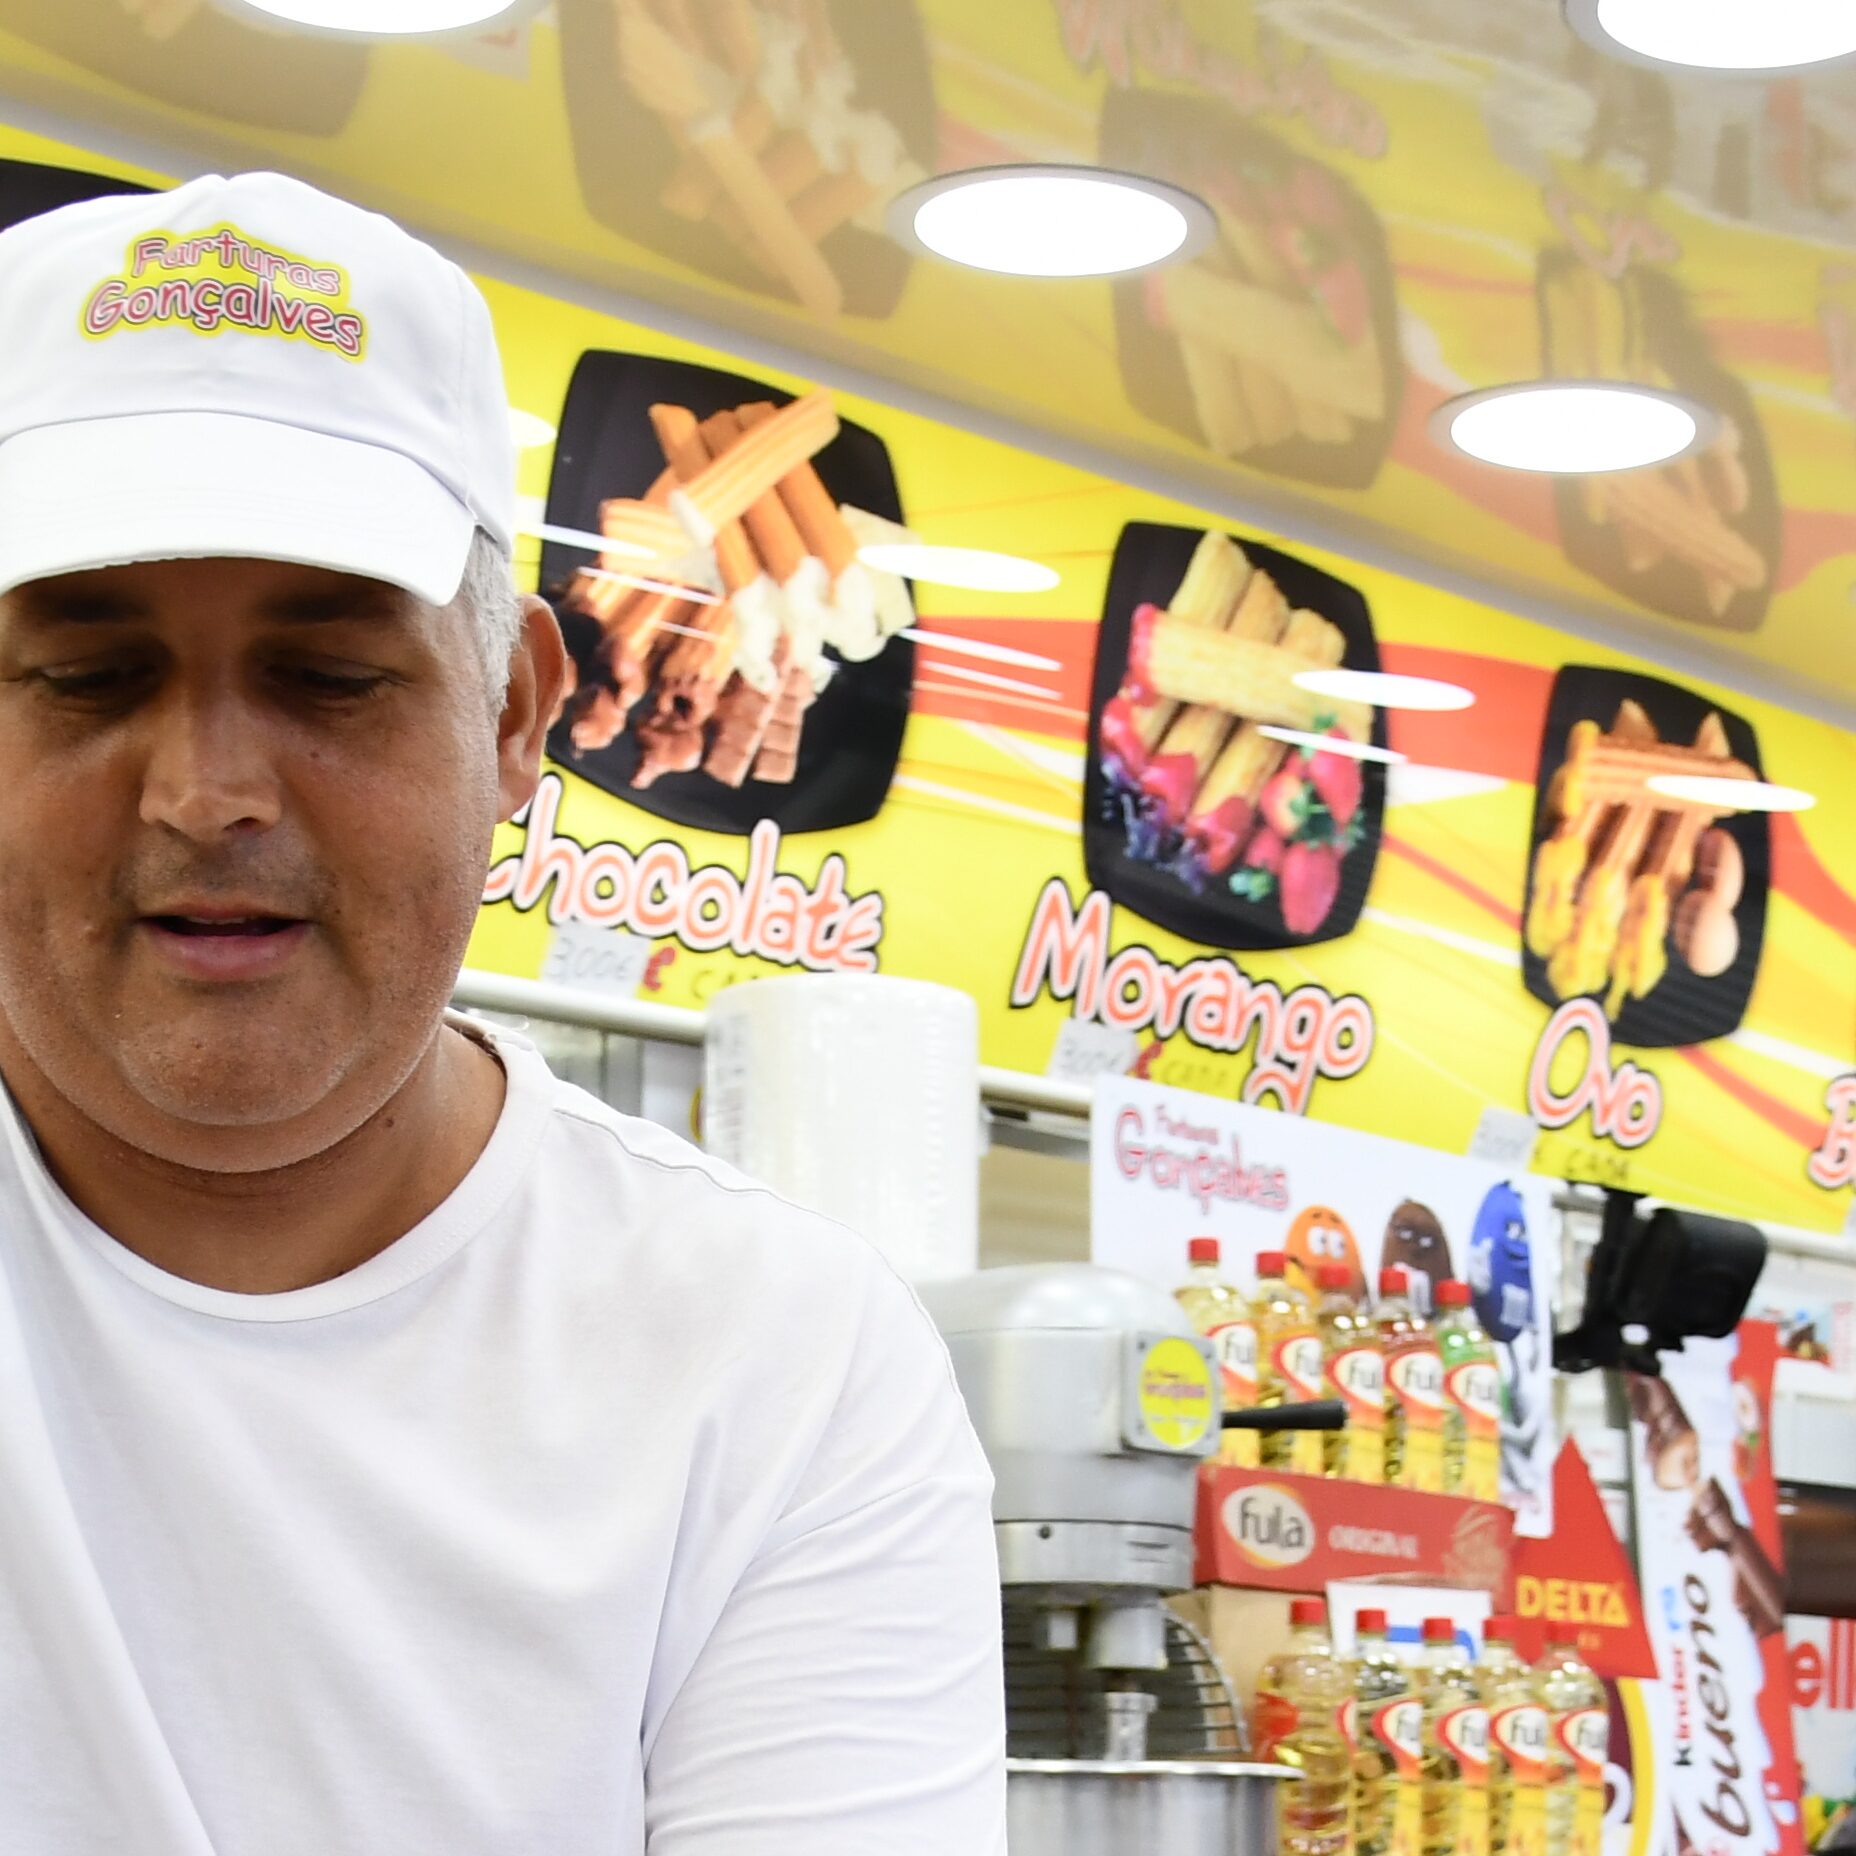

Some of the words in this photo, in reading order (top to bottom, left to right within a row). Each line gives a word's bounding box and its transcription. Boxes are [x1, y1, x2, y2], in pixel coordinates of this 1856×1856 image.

[132, 230, 340, 296] Farturas
[86, 277, 363, 356] Gonçalves
[1008, 877, 1374, 1116] Morango
[1527, 996, 1664, 1149] Ovo
[1239, 1496, 1306, 1549] fula
[1515, 1575, 1631, 1629] DELTA
[1685, 1573, 1752, 1838] bueno
